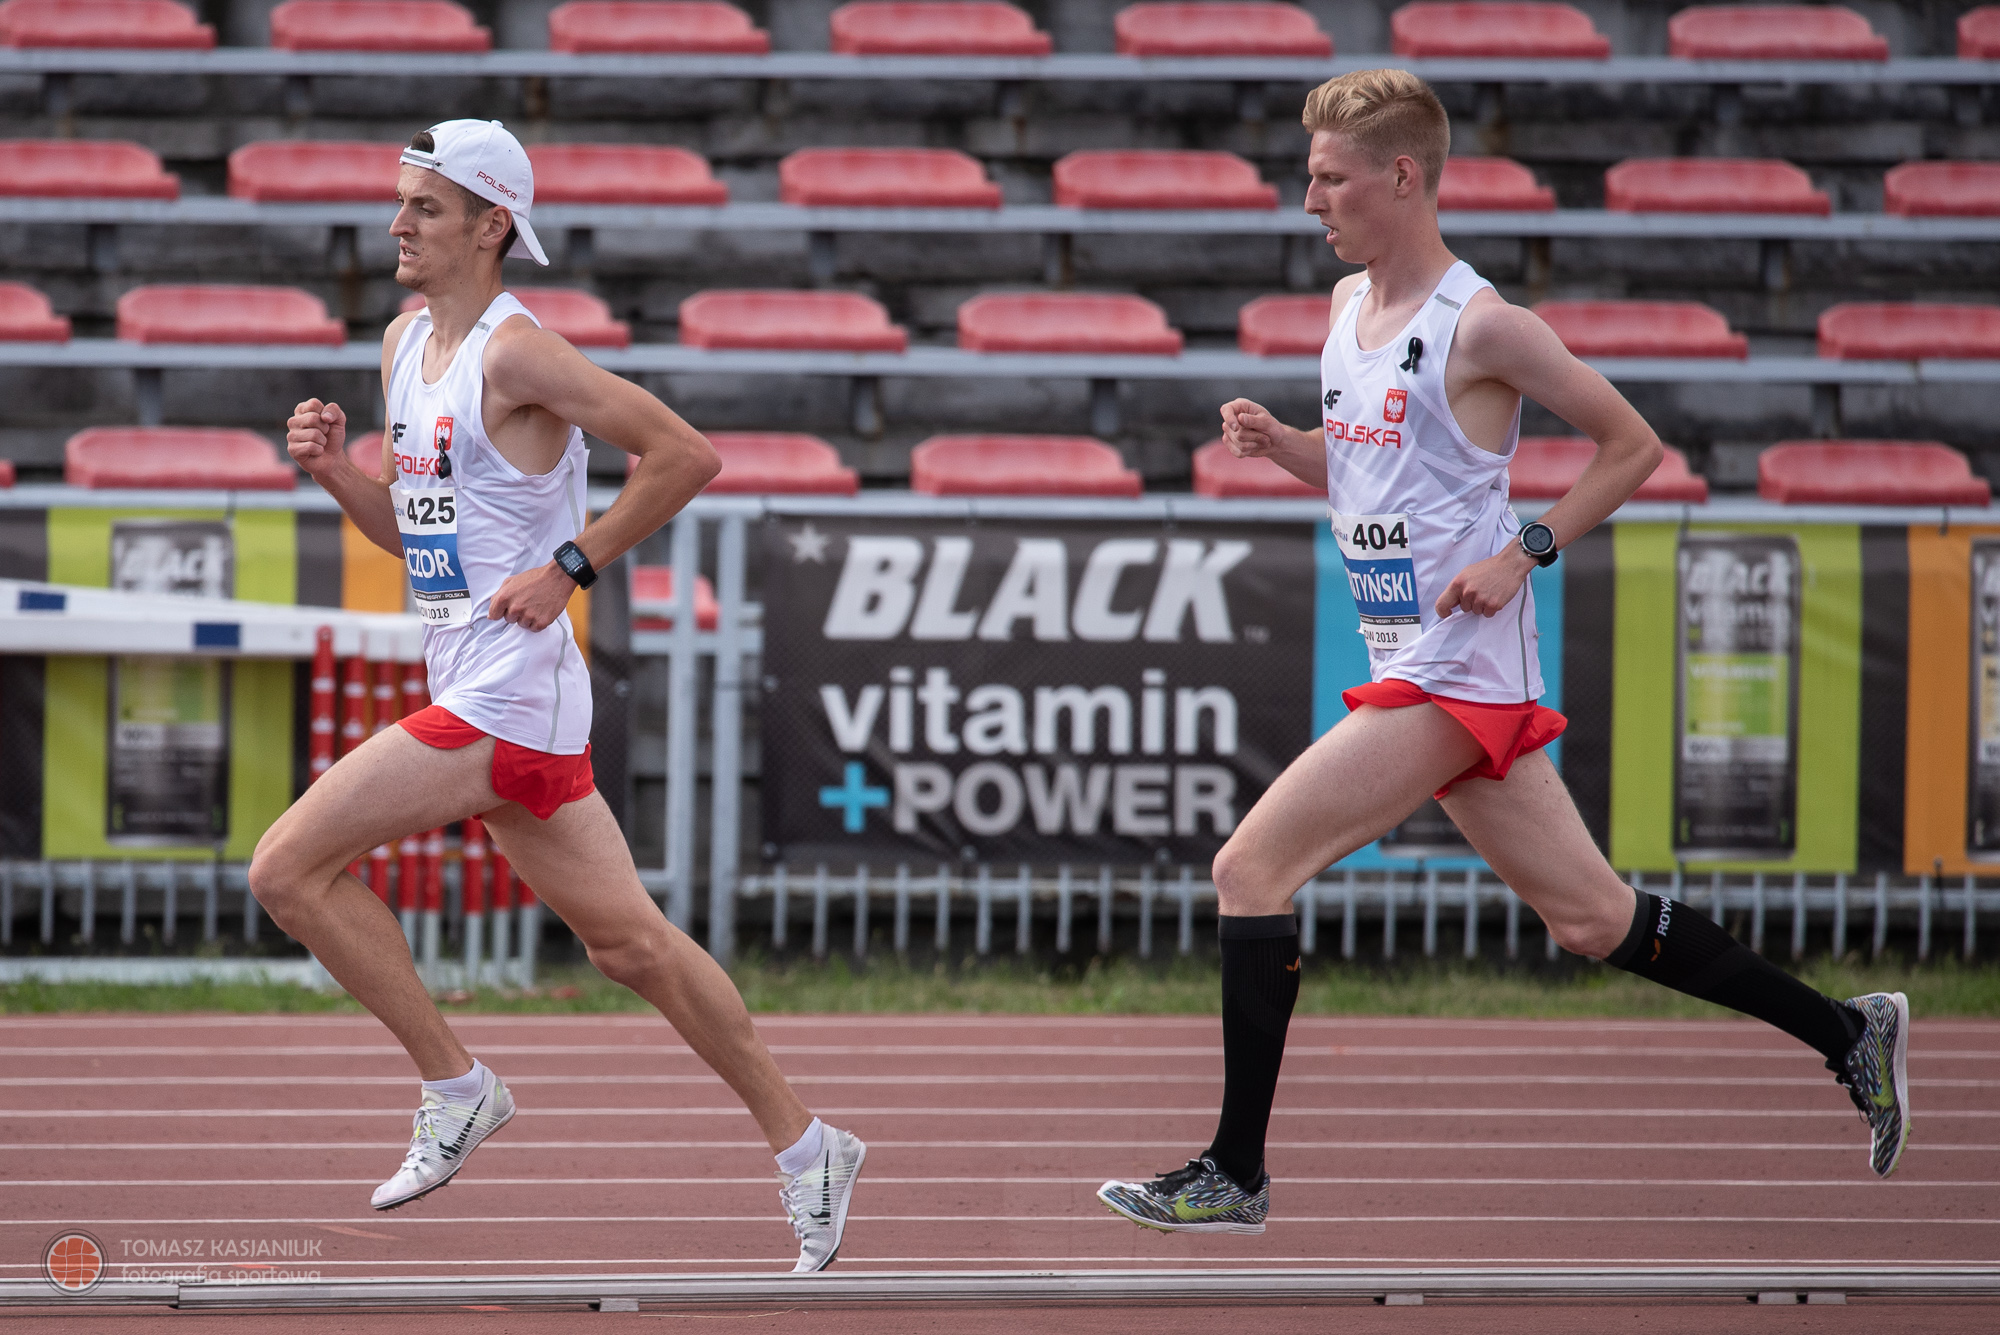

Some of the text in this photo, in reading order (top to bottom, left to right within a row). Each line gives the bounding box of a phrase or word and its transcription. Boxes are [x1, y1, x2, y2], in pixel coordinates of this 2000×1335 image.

[477, 171, 518, 201] POLSKA
[1324, 389, 1342, 410] 4F
[1326, 418, 1402, 448] POLSKA
[407, 496, 456, 526] 425
[1352, 521, 1409, 550] 404
[402, 546, 456, 579] CZOR
[823, 536, 1252, 643] BLACK
[1375, 632, 1399, 643] 2018
[820, 667, 1239, 755] vitamin
